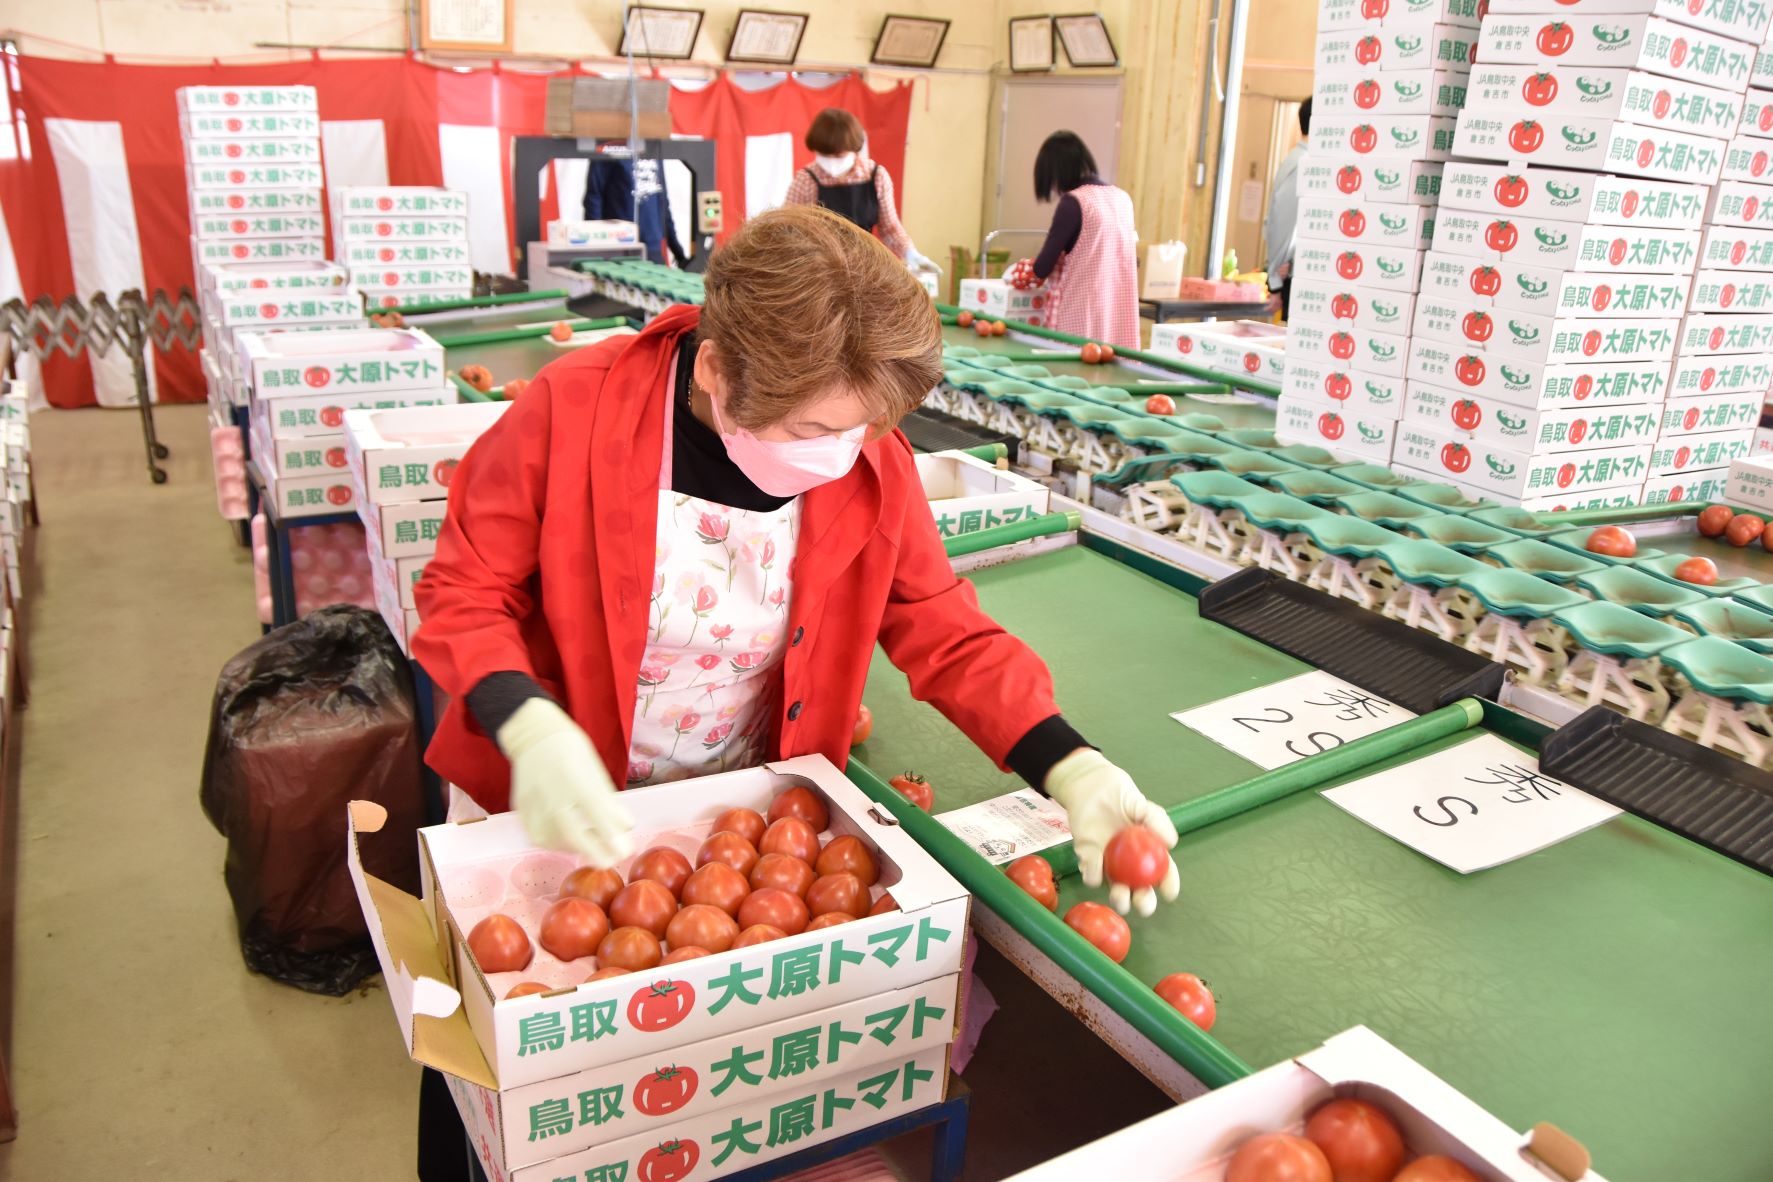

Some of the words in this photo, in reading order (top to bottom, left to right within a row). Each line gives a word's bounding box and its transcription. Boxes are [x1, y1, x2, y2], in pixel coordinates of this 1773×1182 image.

[1439, 40, 1470, 63] 鳥取
[1643, 32, 1671, 59] 鳥取
[1687, 43, 1748, 80] 大原トマト
[1438, 84, 1467, 110] 鳥取
[1625, 86, 1654, 112] 鳥取
[1671, 93, 1735, 128] 大原トマト
[1610, 136, 1638, 161] 鳥取
[1655, 141, 1717, 179] 大原トマト
[1726, 149, 1752, 171] 鳥取
[1594, 190, 1621, 213] 鳥取
[1639, 191, 1701, 218] 大原トマト
[1719, 195, 1744, 216] 鳥取
[1581, 239, 1609, 261] 鳥取
[1628, 239, 1693, 265] 大原トマト
[1707, 240, 1732, 260] 鳥取
[1562, 286, 1591, 307] 鳥取
[1613, 284, 1683, 310] 大原トマト
[1697, 284, 1720, 304] 鳥取
[284, 301, 357, 317] 大原トマト
[1553, 332, 1582, 353] 鳥取
[1603, 329, 1671, 354] 大原トマト
[1686, 328, 1710, 347] 鳥取
[264, 369, 301, 387] 鳥取
[335, 359, 437, 384] 大原トマト
[1543, 377, 1573, 398] 鳥取
[1594, 372, 1663, 397] 大原トマト
[1677, 370, 1701, 388] 鳥取
[1715, 365, 1770, 387] 大原トマト
[280, 409, 317, 427] 鳥取
[1539, 422, 1568, 443] 鳥取
[1588, 414, 1656, 441] 大原トマト
[1663, 410, 1684, 428] 鳥取
[1700, 403, 1757, 426] 大原トマト
[286, 450, 322, 467] 鳥取
[1651, 449, 1674, 468] 鳥取
[1690, 440, 1747, 465] 大原トマト
[380, 464, 429, 488] 鳥取
[1528, 467, 1557, 488] 鳥取
[1577, 455, 1644, 484] 大原トマト
[288, 488, 324, 505] 鳥取
[396, 518, 441, 543] 鳥取
[1304, 689, 1390, 721] 秀
[1464, 764, 1562, 803] 秀
[1413, 796, 1478, 826] S
[517, 999, 618, 1058] 鳥取
[707, 917, 951, 1016] 大原トマト
[527, 1084, 624, 1142] 鳥取
[710, 997, 945, 1096] 大原トマト
[711, 1061, 934, 1167] 大原トマト
